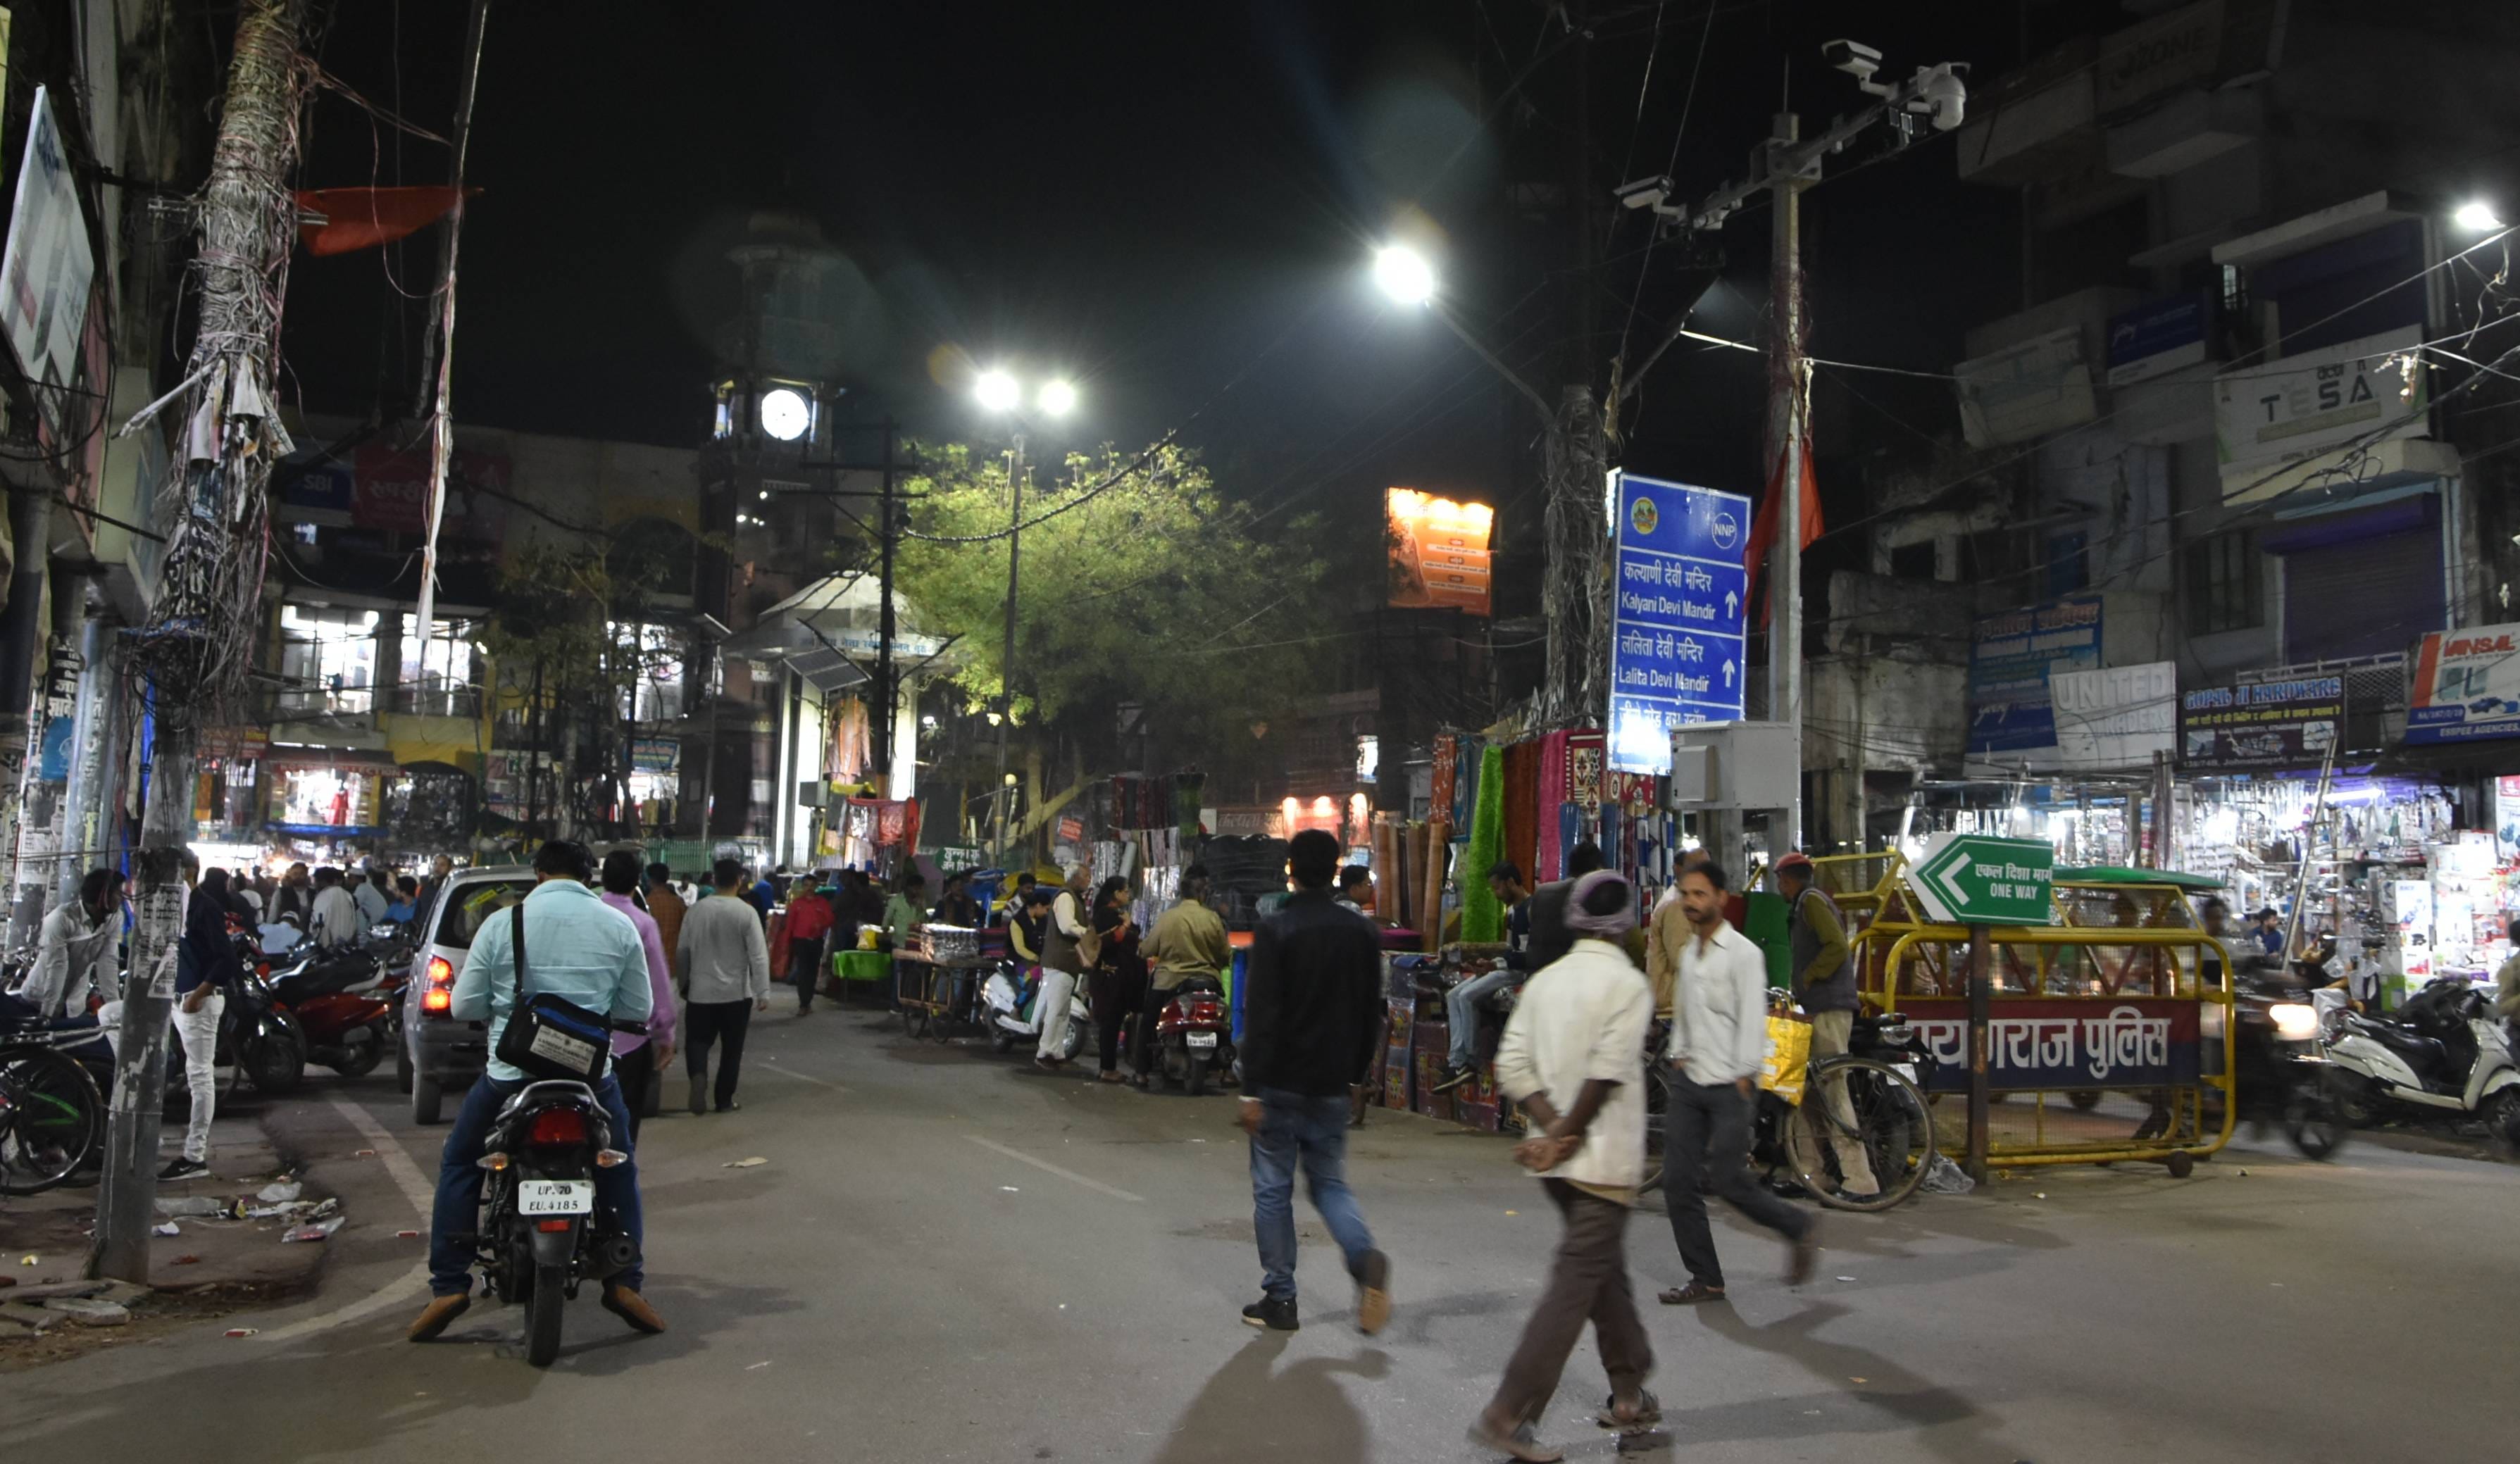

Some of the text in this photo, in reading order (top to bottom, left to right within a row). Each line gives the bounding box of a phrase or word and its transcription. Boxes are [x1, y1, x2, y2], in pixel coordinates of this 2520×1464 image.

[304, 475, 333, 492] SBI
[1714, 523, 1735, 537] NNP
[1624, 558, 1712, 592] कल्याणी देवी मन्दिर
[1621, 591, 1716, 620] Kalyani Devi Mandir
[1621, 629, 1704, 663] ललिता देवी मन्दिर
[1618, 665, 1709, 692] Lalita Devi Mandir
[2053, 670, 2164, 711] UNITED
[2185, 677, 2342, 710] GOPAL JI HARDWARE
[1975, 863, 2004, 880] एकल
[2006, 862, 2031, 881] दिशा
[1990, 882, 2038, 900] ONE WAY
[2082, 1006, 2172, 1080] पुलिस
